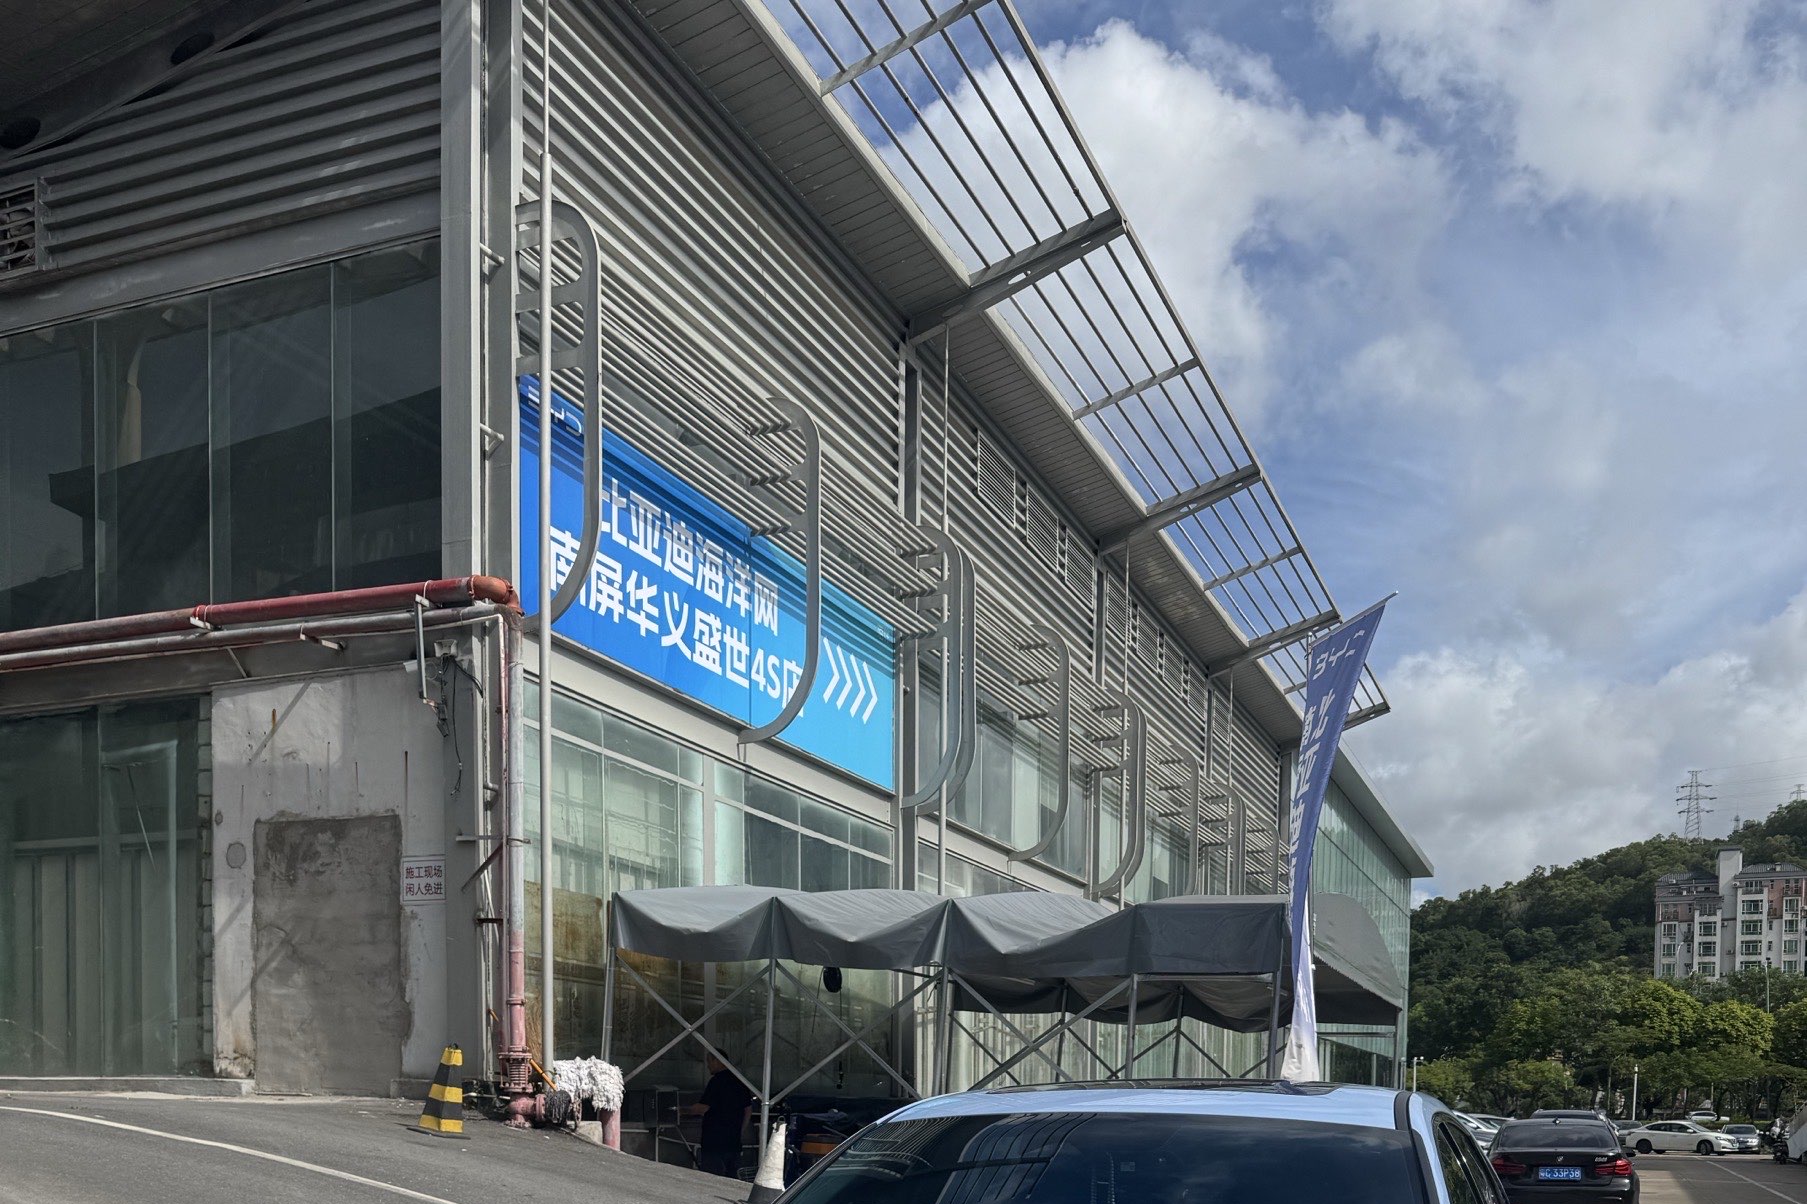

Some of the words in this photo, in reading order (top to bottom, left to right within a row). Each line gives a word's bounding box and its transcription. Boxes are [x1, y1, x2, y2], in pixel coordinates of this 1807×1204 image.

[600, 477, 779, 637] 比亚迪海洋网
[405, 865, 443, 879] 施工现场
[405, 882, 443, 896] 闲人免进
